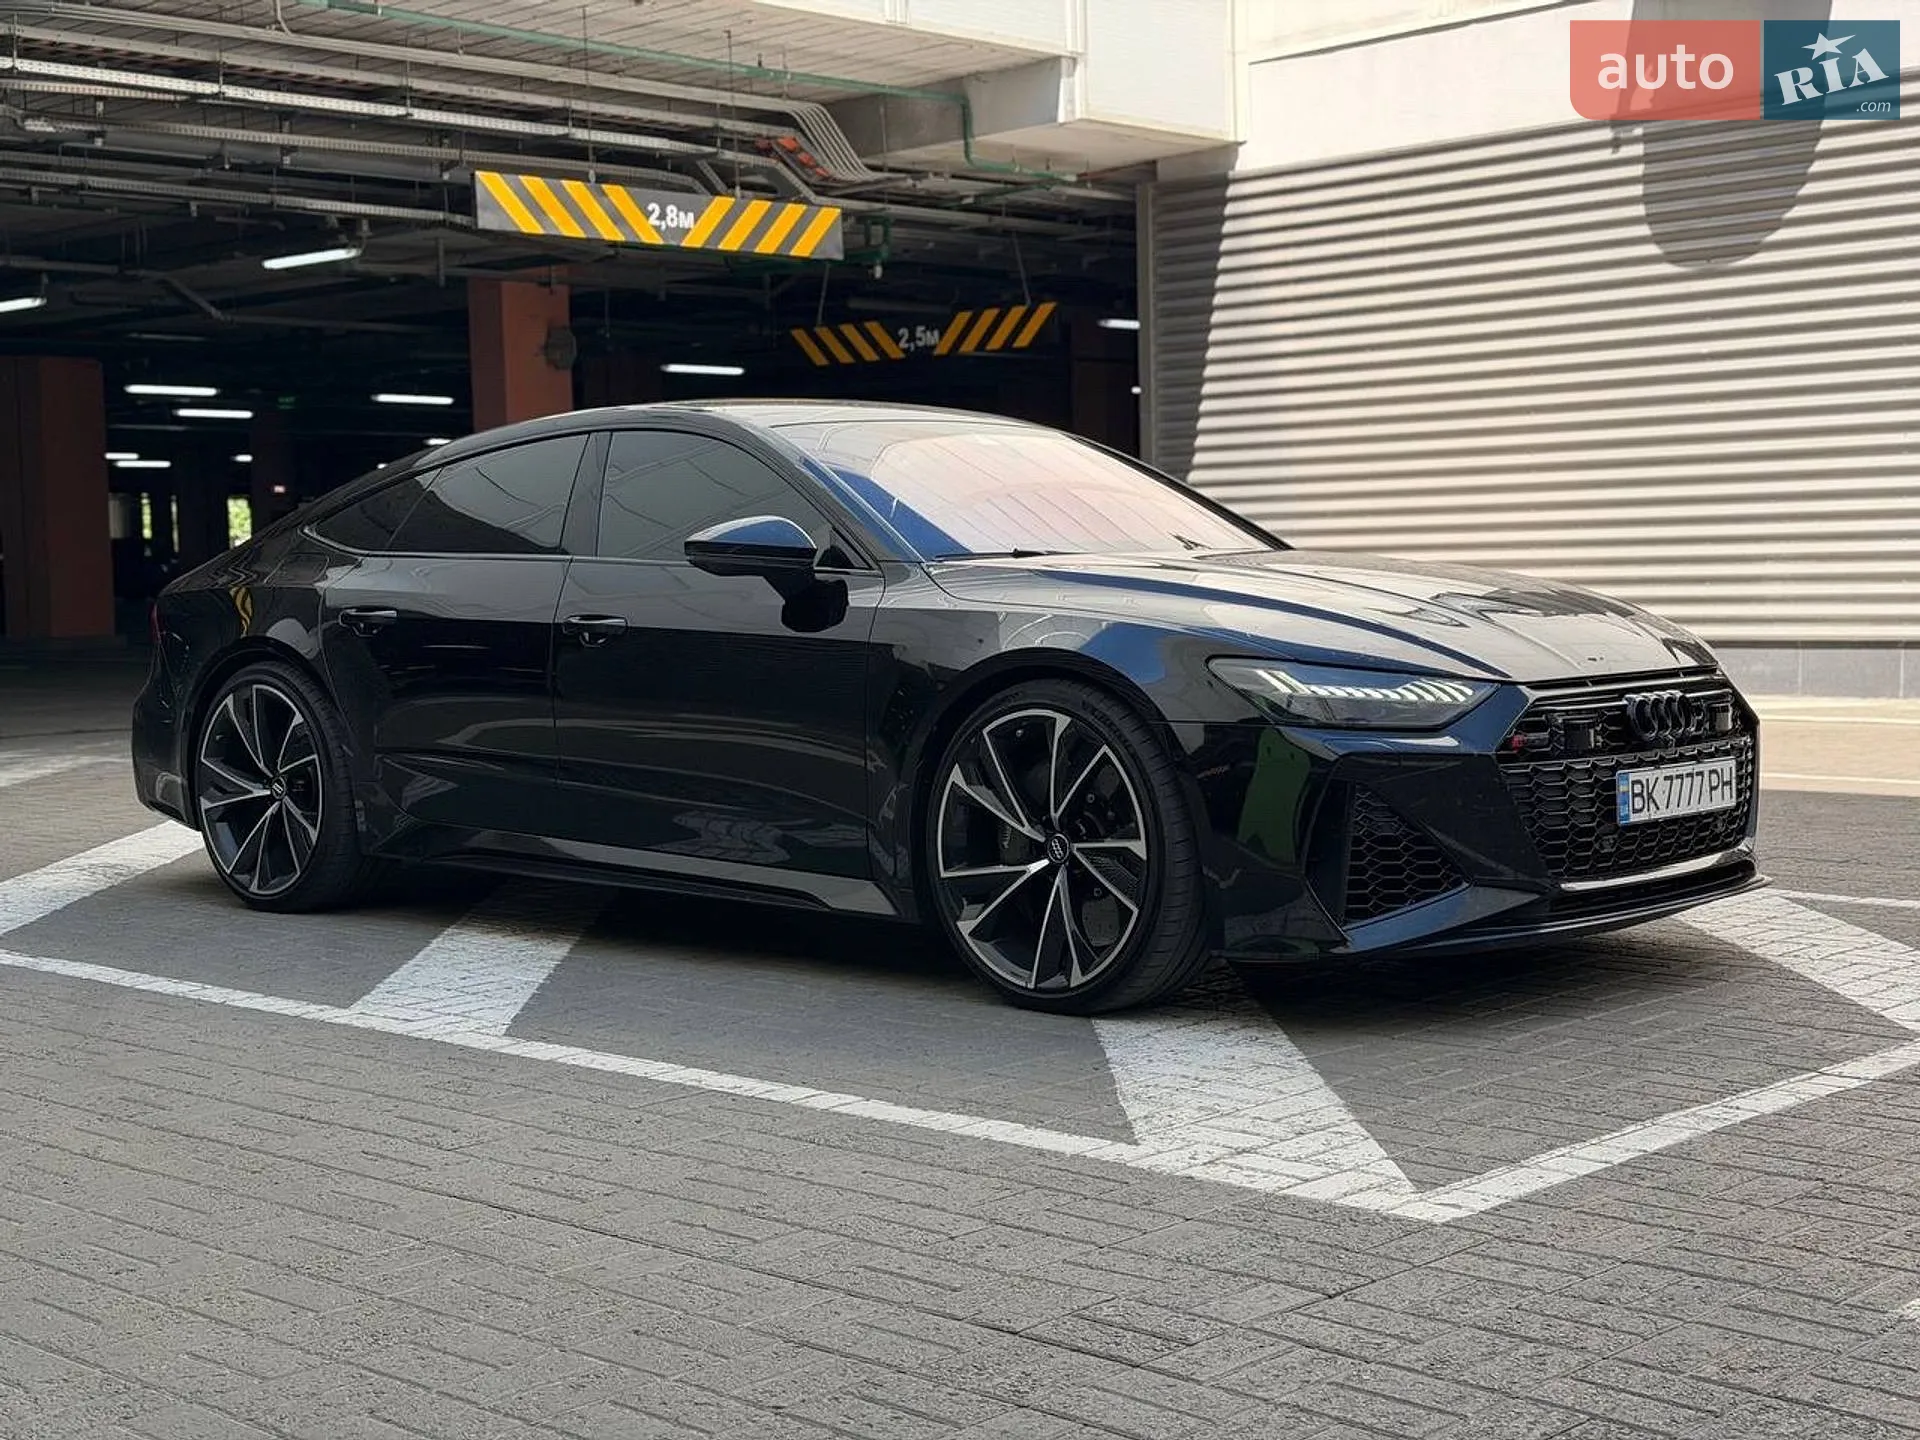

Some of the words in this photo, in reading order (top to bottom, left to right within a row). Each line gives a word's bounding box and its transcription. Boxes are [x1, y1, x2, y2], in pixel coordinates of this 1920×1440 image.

[1631, 777, 1660, 815] BK
[1663, 770, 1705, 809] 7777
[1708, 766, 1734, 803] PH
